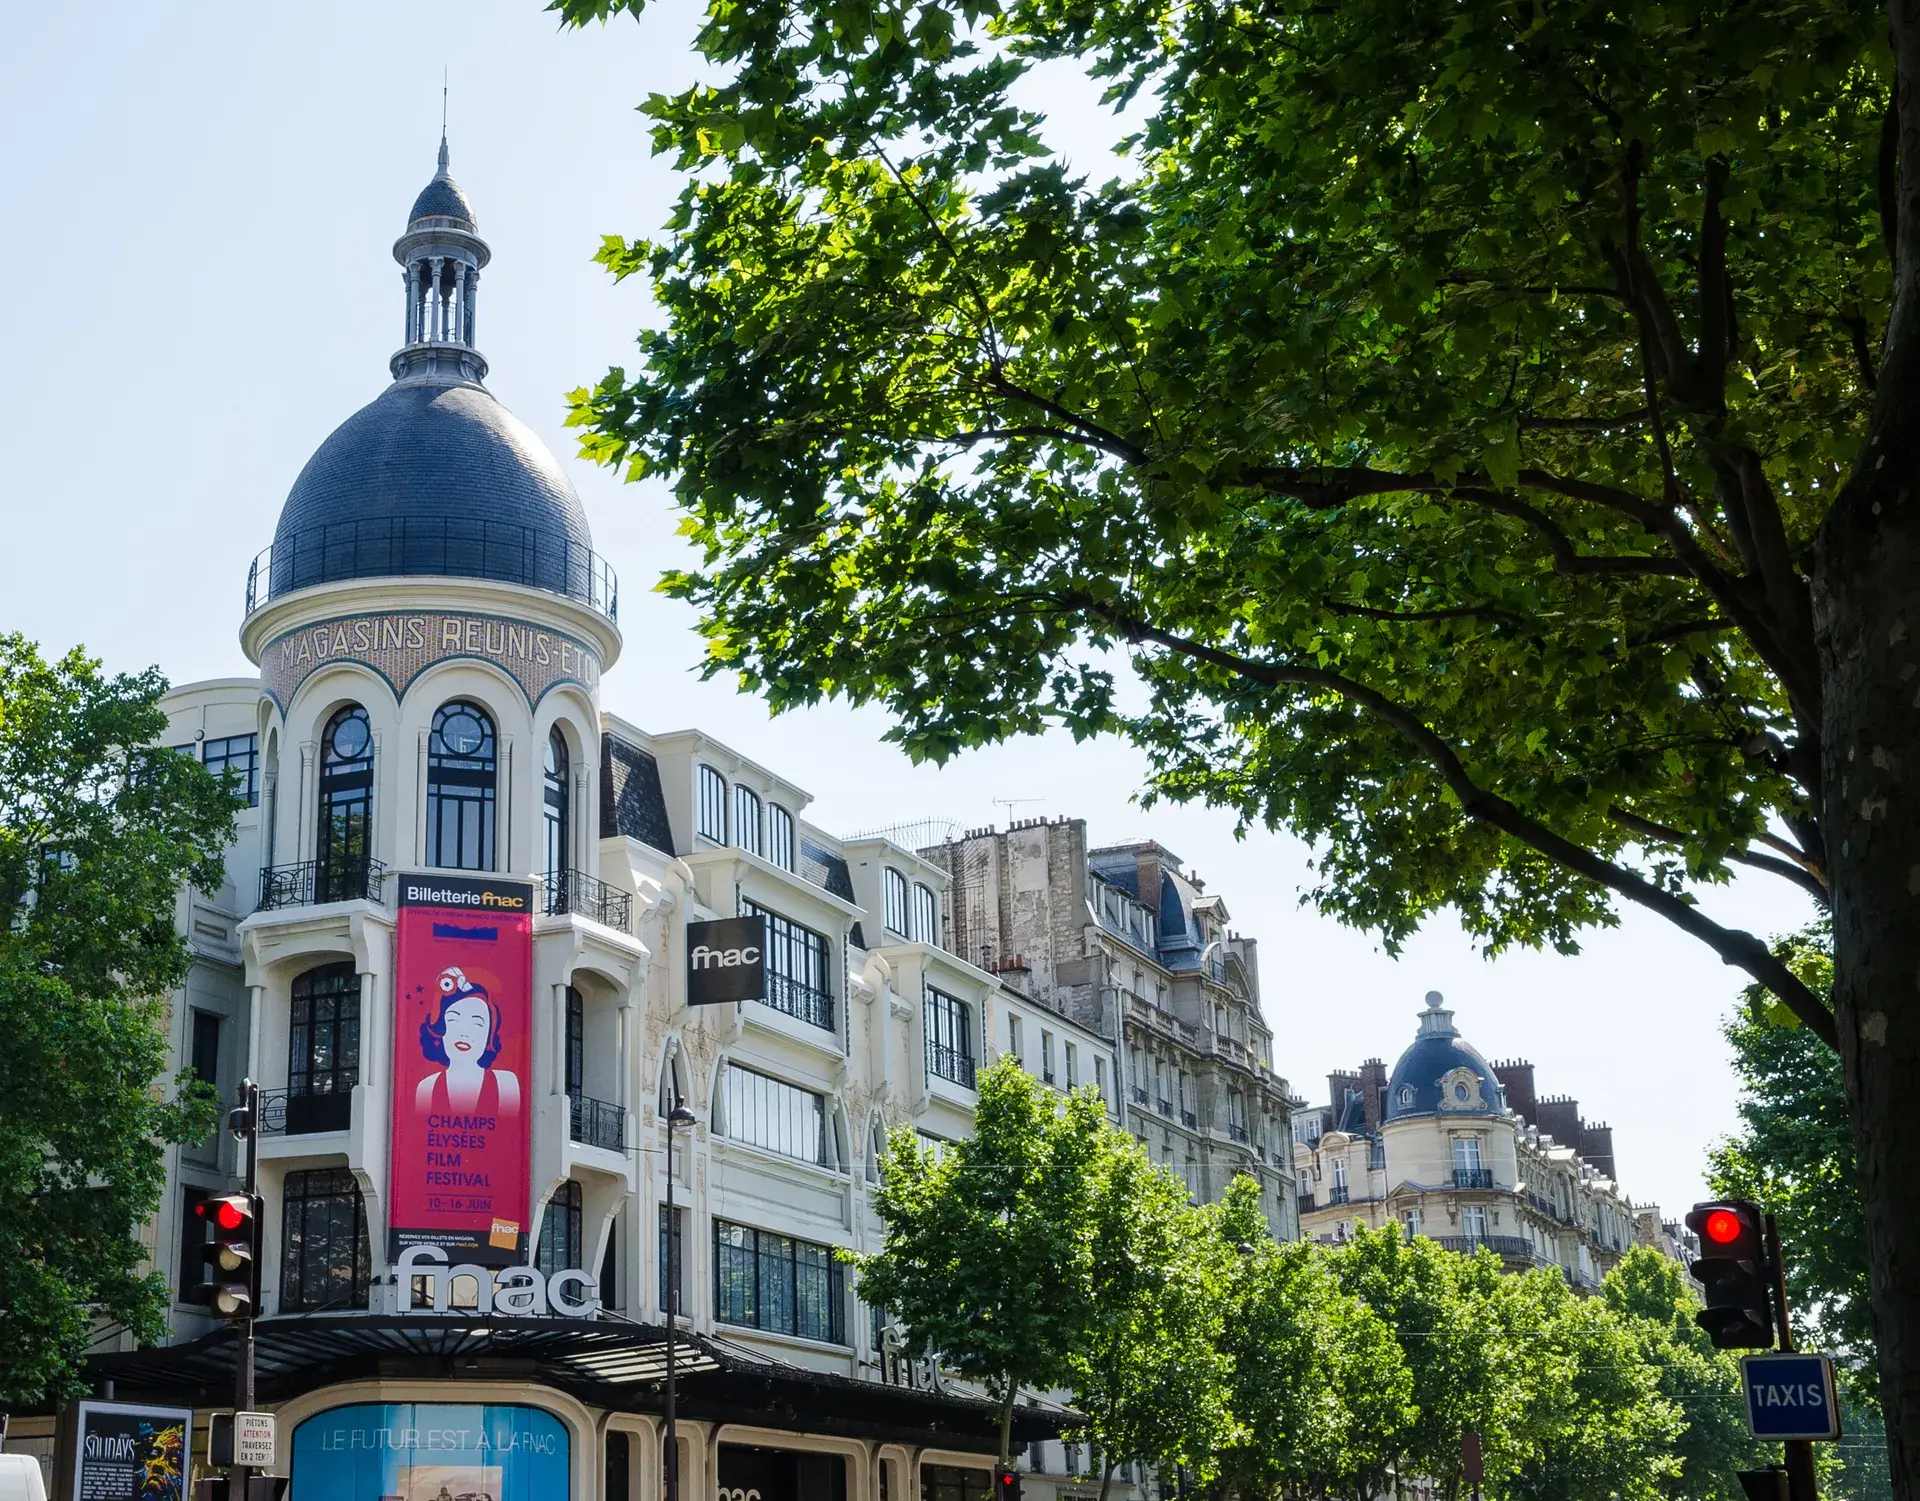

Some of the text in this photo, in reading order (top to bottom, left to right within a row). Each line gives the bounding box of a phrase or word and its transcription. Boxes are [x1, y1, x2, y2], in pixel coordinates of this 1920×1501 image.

[280, 617, 425, 671] MAGASINS
[407, 885, 524, 908] Billetterie fnac
[691, 945, 760, 970] fnac
[427, 1114, 496, 1131] CHAMPS
[427, 1128, 486, 1149] ÉLYSÉES
[427, 1151, 462, 1167] FILM
[426, 1171, 491, 1188] FESTIVAL
[467, 1199, 491, 1210] JUIN
[490, 1222, 519, 1234] fnac
[391, 1245, 599, 1317] fnac
[1752, 1384, 1823, 1407] TAXIS
[243, 1429, 271, 1438] ATTENTION
[322, 1429, 346, 1451] LE
[350, 1428, 421, 1450] FUTUR
[427, 1429, 471, 1451] EST
[475, 1425, 491, 1451] À
[522, 1431, 555, 1455] FNAC
[84, 1435, 136, 1462] SOLIDAYS
[242, 1441, 272, 1450] TRAVERSEZ
[240, 1452, 248, 1461] EN
[249, 1452, 254, 1461] 2
